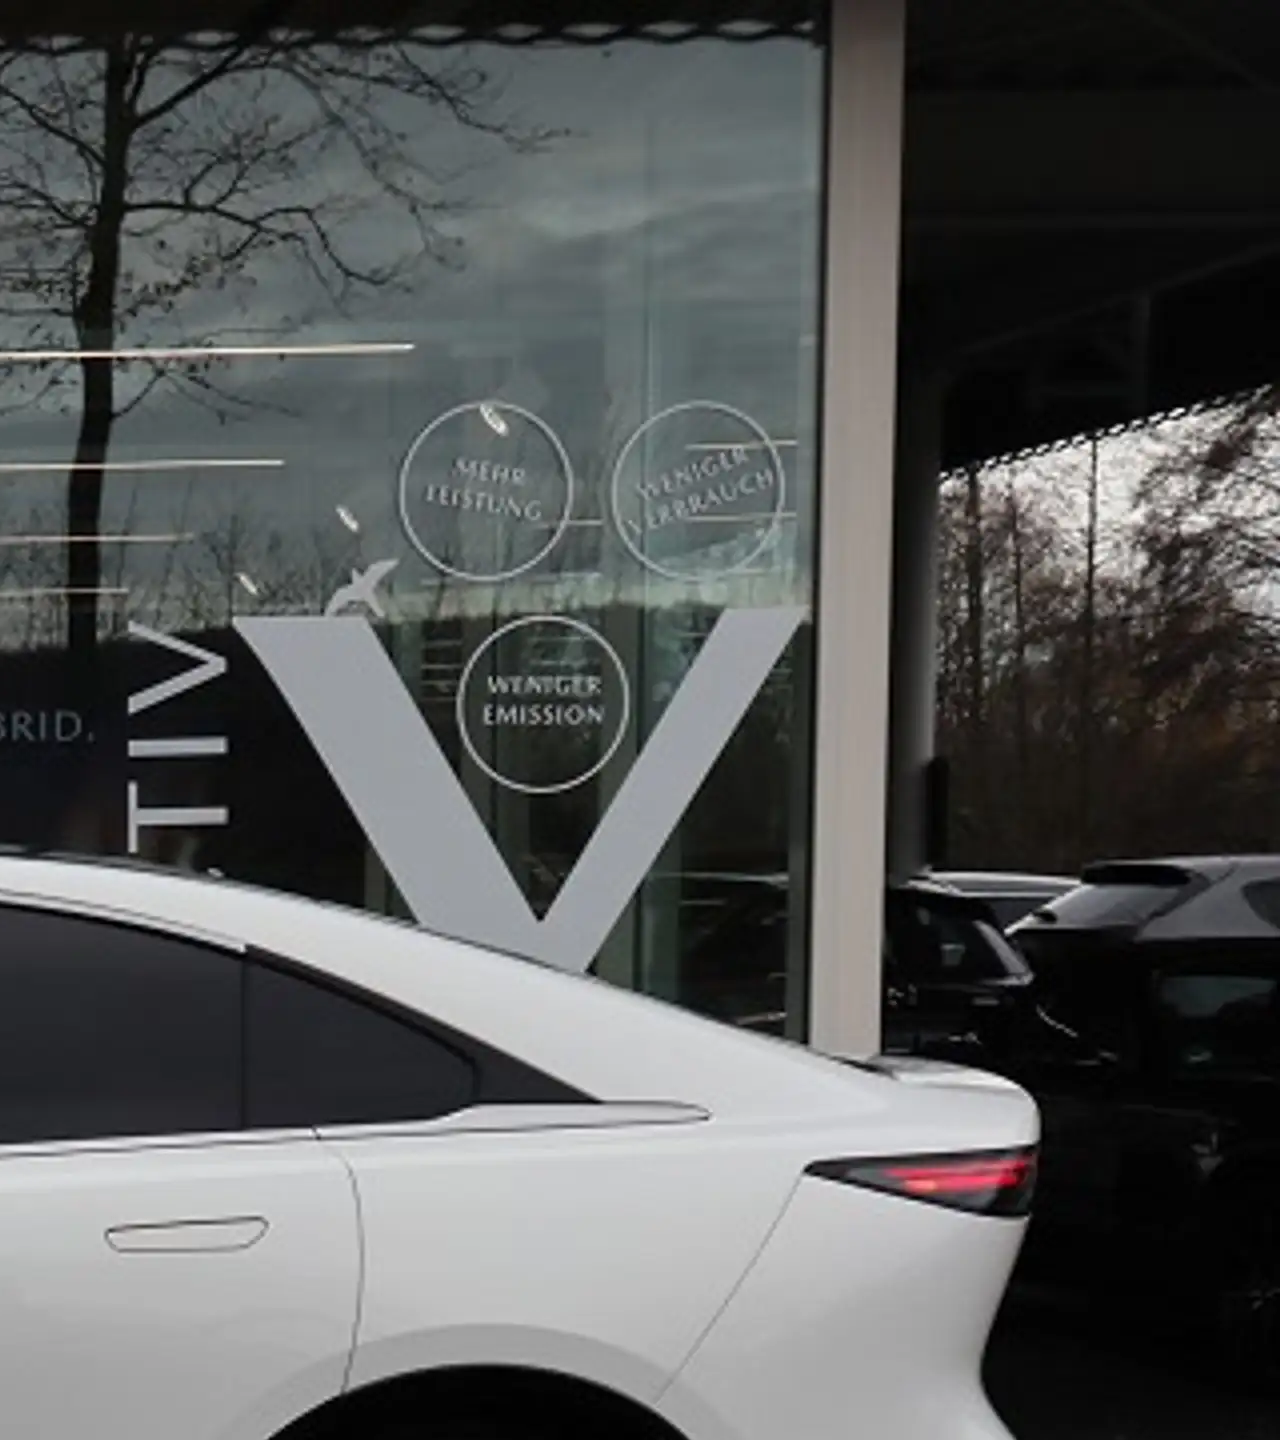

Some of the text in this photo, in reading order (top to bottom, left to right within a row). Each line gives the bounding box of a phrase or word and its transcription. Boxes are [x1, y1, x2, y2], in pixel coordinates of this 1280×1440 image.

[451, 457, 526, 487] MEHR
[635, 445, 750, 500] WENIGER
[425, 483, 542, 521] LEISTUNG
[627, 467, 774, 536] VERBRAUCH
[486, 674, 602, 694] WENIGER
[483, 703, 606, 726] EMISSION
[128, 619, 228, 876] TIV
